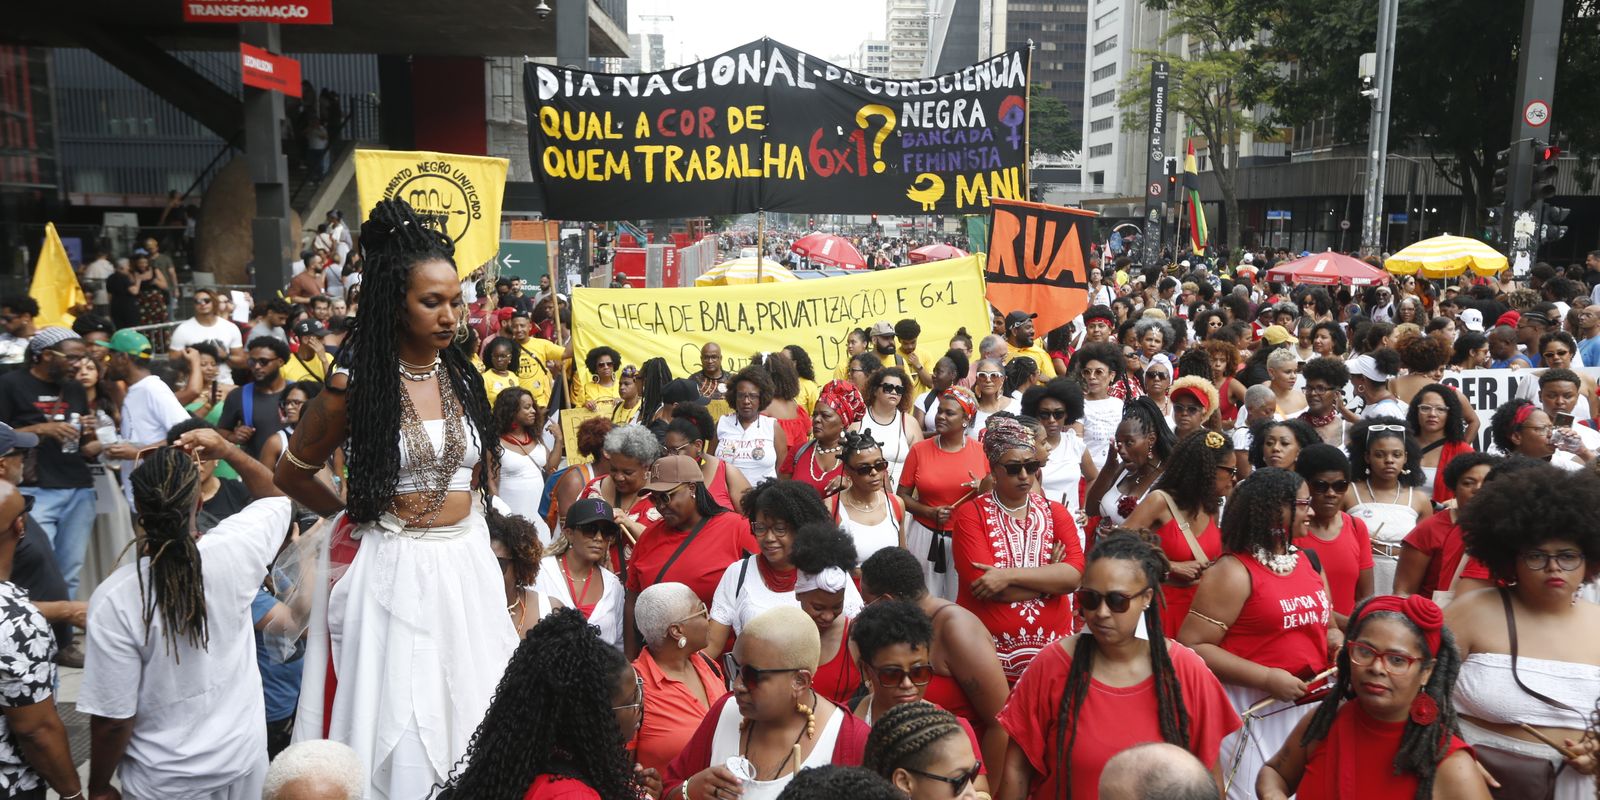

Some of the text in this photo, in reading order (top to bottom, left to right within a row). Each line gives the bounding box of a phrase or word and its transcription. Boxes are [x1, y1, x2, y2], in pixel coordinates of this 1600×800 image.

[188, 4, 309, 18] TRANSFORMAÇÃO
[536, 66, 600, 100] DIA
[612, 47, 816, 97] NACIONAL
[539, 105, 765, 141] QUAL A COR DE
[901, 98, 986, 129] NEGRA
[1154, 86, 1163, 134] Pamplona
[902, 127, 994, 148] BANCADA
[543, 146, 631, 181] QUEM
[634, 142, 805, 183] TRABALHA
[416, 161, 451, 174] NEGRO
[453, 169, 482, 220] UNIFICADO
[987, 208, 1087, 283] RUA
[598, 280, 958, 335] CHEGA DE BALA, PRIVATIZAÇÃO E 6x1
